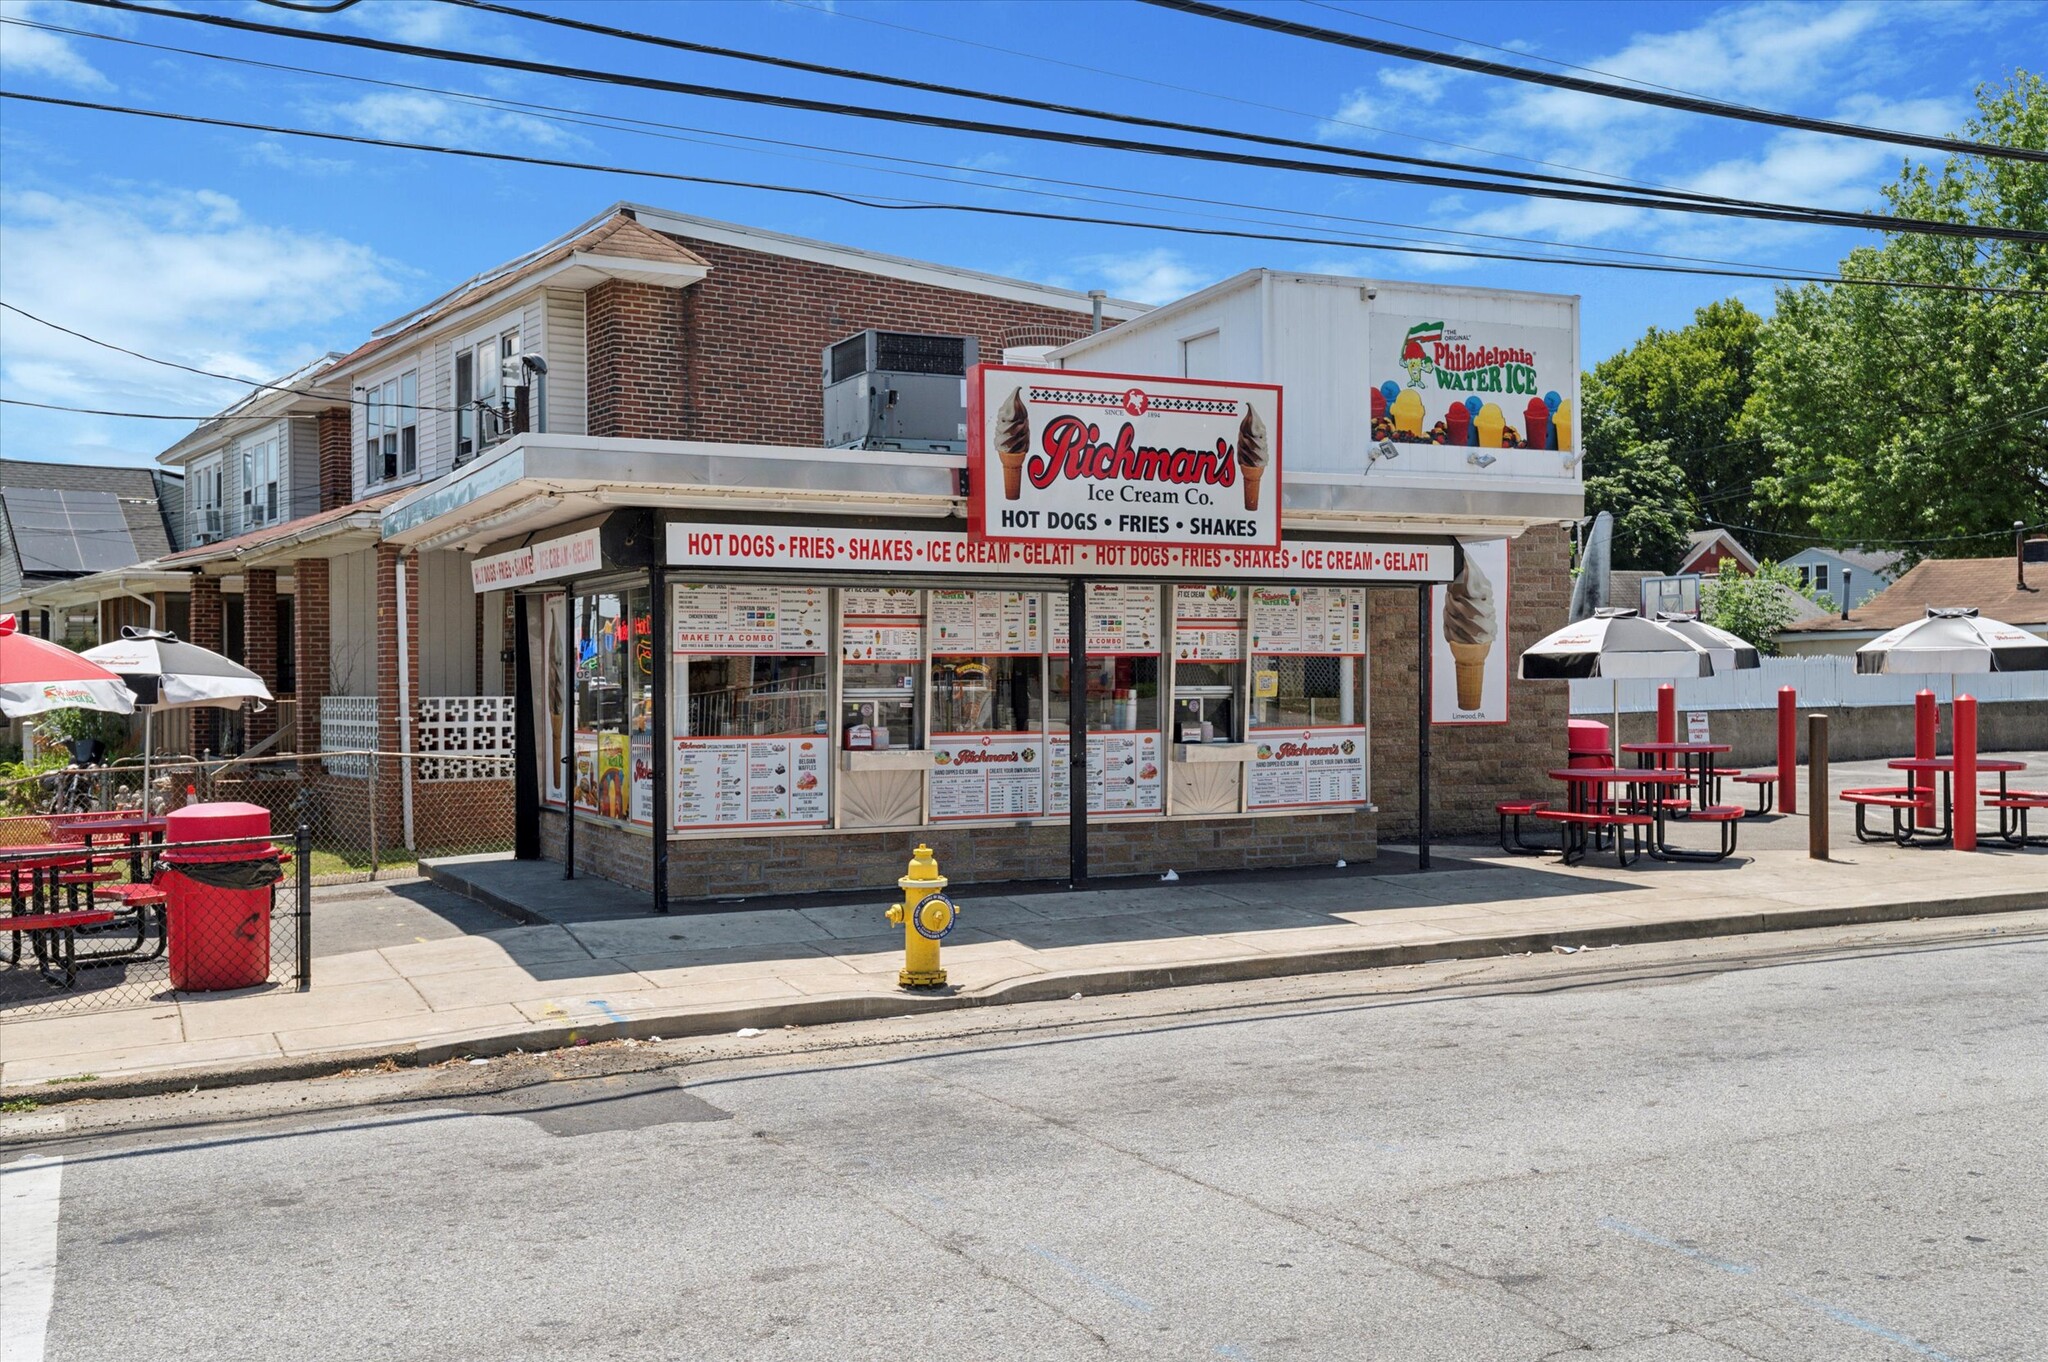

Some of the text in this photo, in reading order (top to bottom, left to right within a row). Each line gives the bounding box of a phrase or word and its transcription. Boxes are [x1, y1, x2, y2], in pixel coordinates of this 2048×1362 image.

[1433, 342, 1533, 371] Philadelphia
[1435, 363, 1538, 395] WATER ICE
[1104, 409, 1124, 417] SINCE
[1027, 414, 1236, 489] Richman's
[1088, 484, 1213, 506] Ice Cream Co.
[1001, 510, 1256, 537] HOT DOGS FRIES SHAKES
[688, 533, 1428, 571] HOT DOGS FRIES SHAKES ICE CREAM GELATI HOT DOGS FRIES SHAKES ICE CREAM GELATI
[954, 749, 1018, 766] Richman's
[1275, 742, 1339, 760] Richman's
